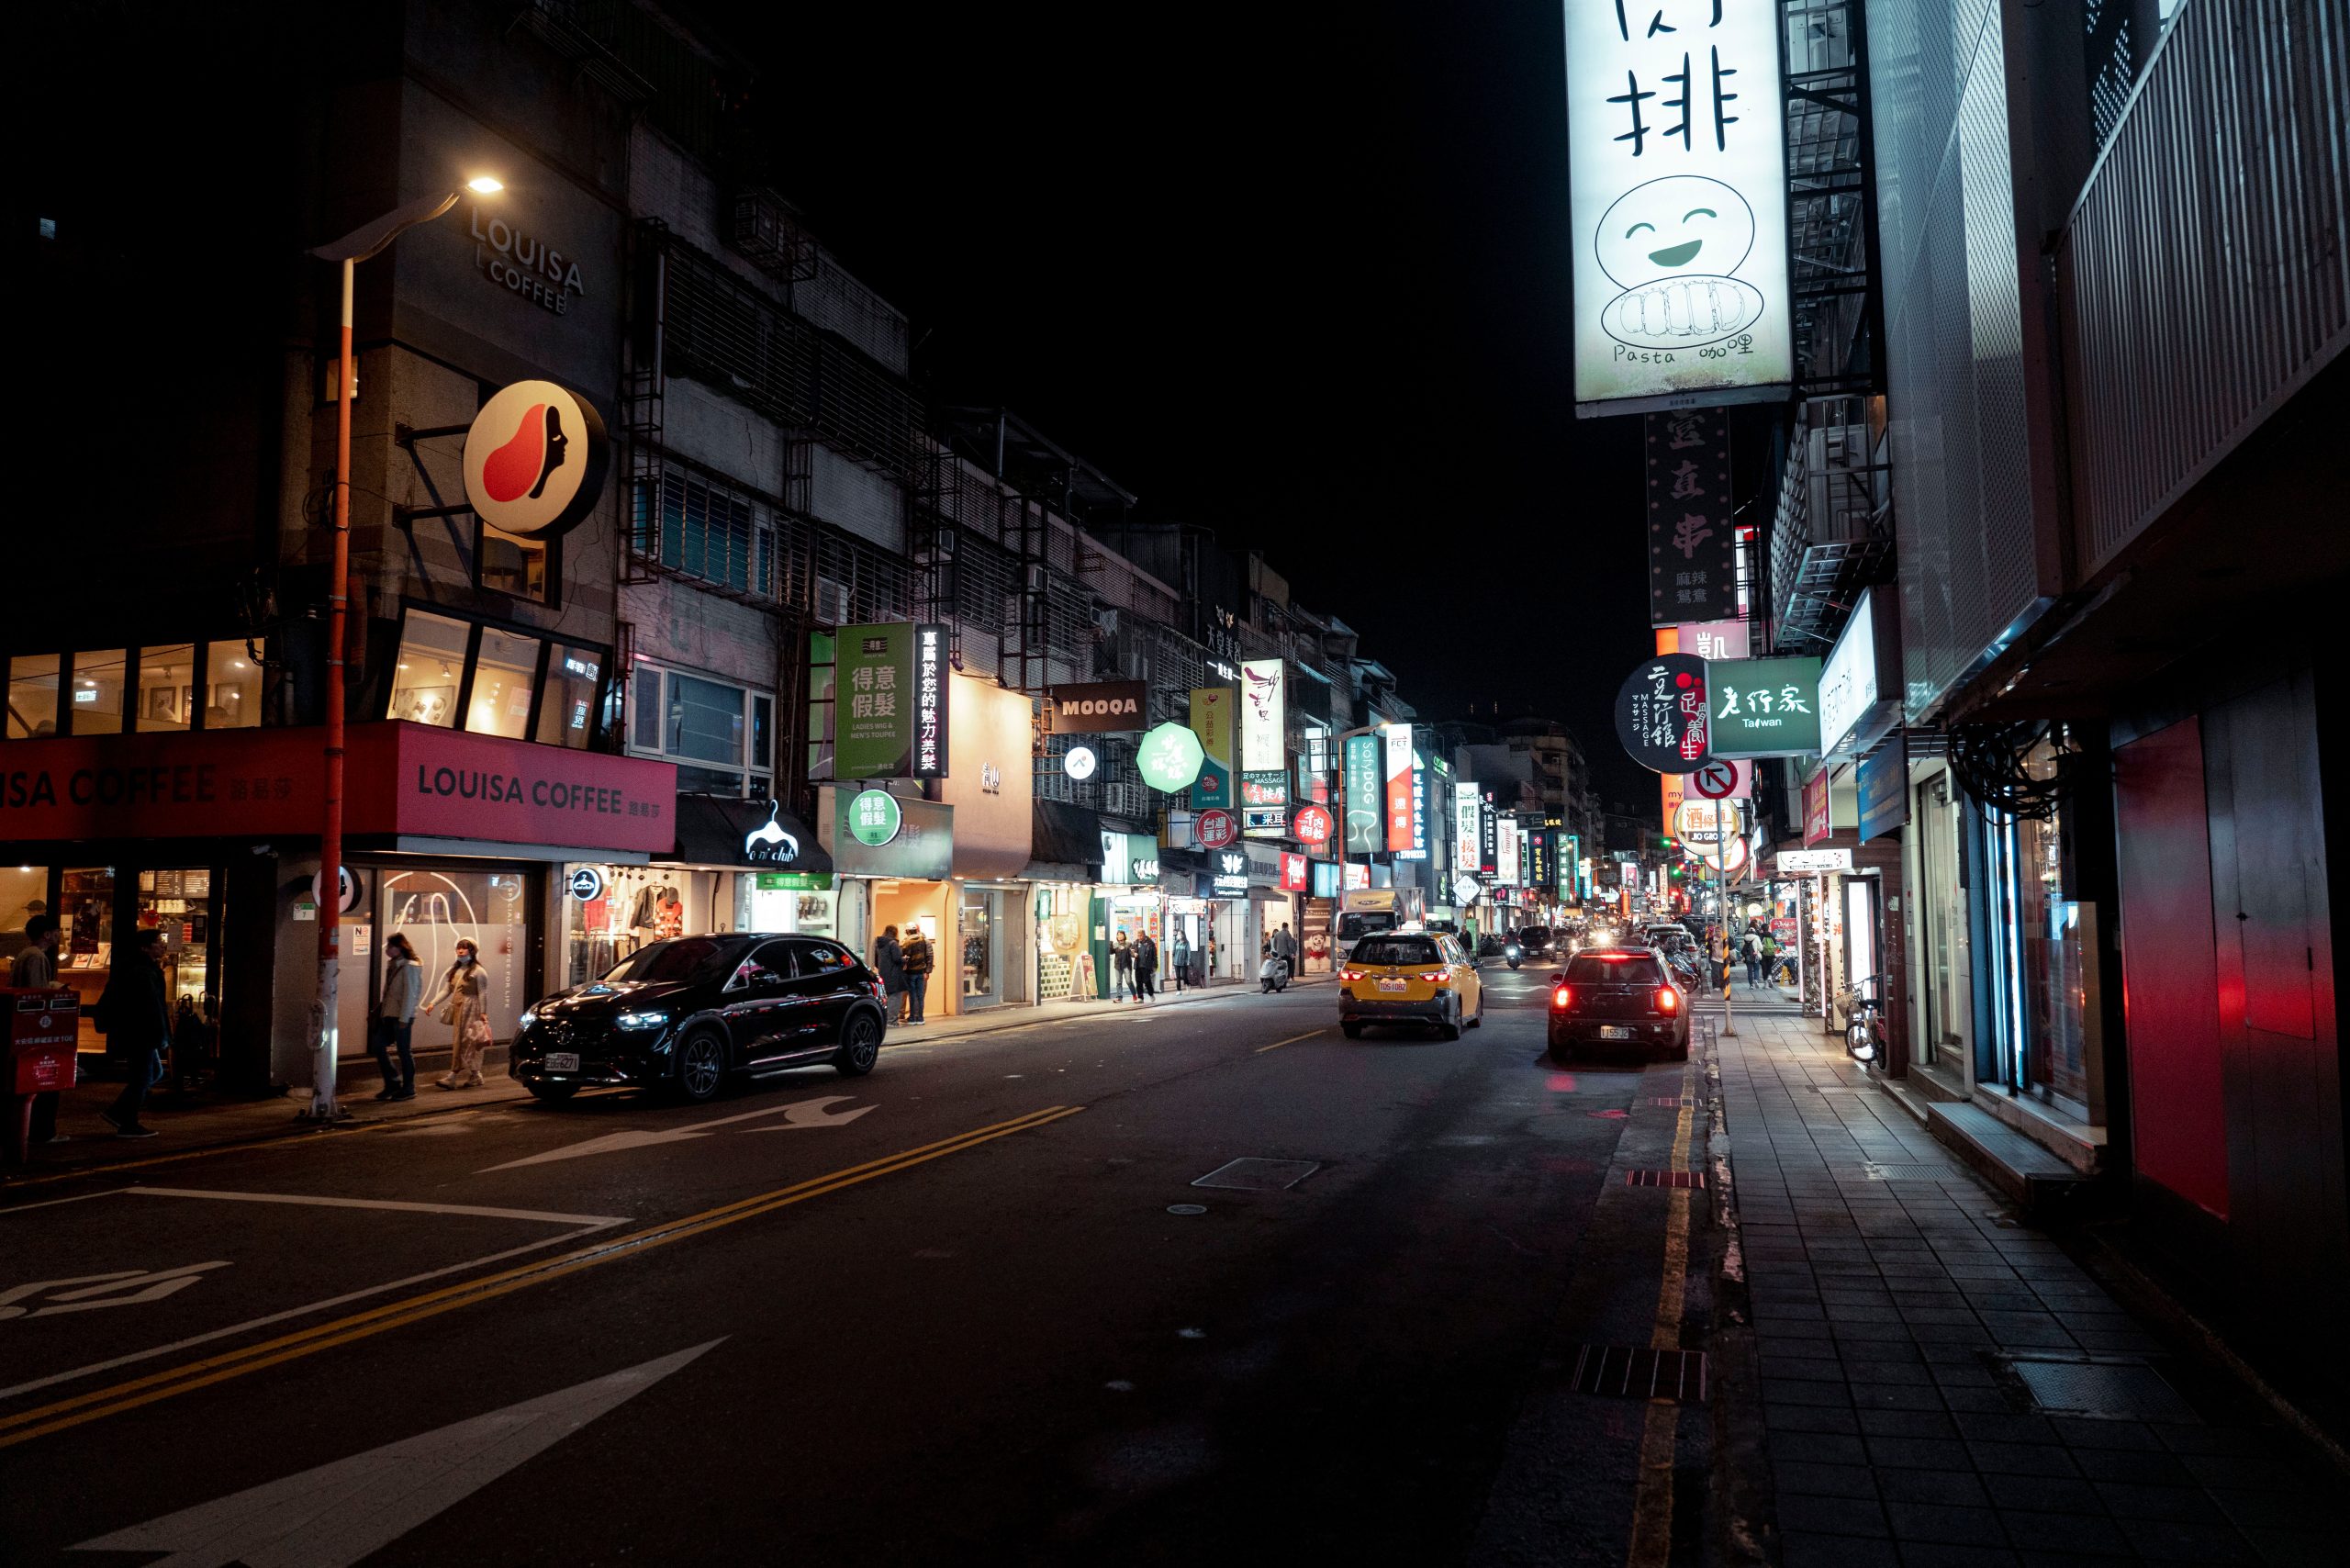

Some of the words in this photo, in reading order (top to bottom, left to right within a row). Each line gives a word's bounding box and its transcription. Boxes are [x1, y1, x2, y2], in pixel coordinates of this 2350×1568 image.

[471, 207, 584, 296] LOUISA
[490, 261, 566, 314] COFFEE
[1614, 344, 1675, 364] Pasta
[1676, 570, 1707, 586] 麻辣
[851, 666, 896, 691] 得意
[851, 692, 896, 718] 假髮
[1062, 698, 1138, 715] MOOQA
[1718, 683, 1811, 719] 老行家
[1640, 694, 1649, 746] MASSAGE
[70, 764, 218, 804] COFFEE
[1361, 742, 1375, 804] SofyDOG
[419, 765, 523, 804] LOUISA
[532, 780, 622, 814] COFFEE
[1263, 786, 1286, 801] 按摩
[859, 797, 885, 812] 得意
[859, 812, 886, 826] 假髮
[1203, 816, 1226, 829] 台灣
[1691, 833, 1703, 841] JIO
[1704, 833, 1726, 841] GROP
